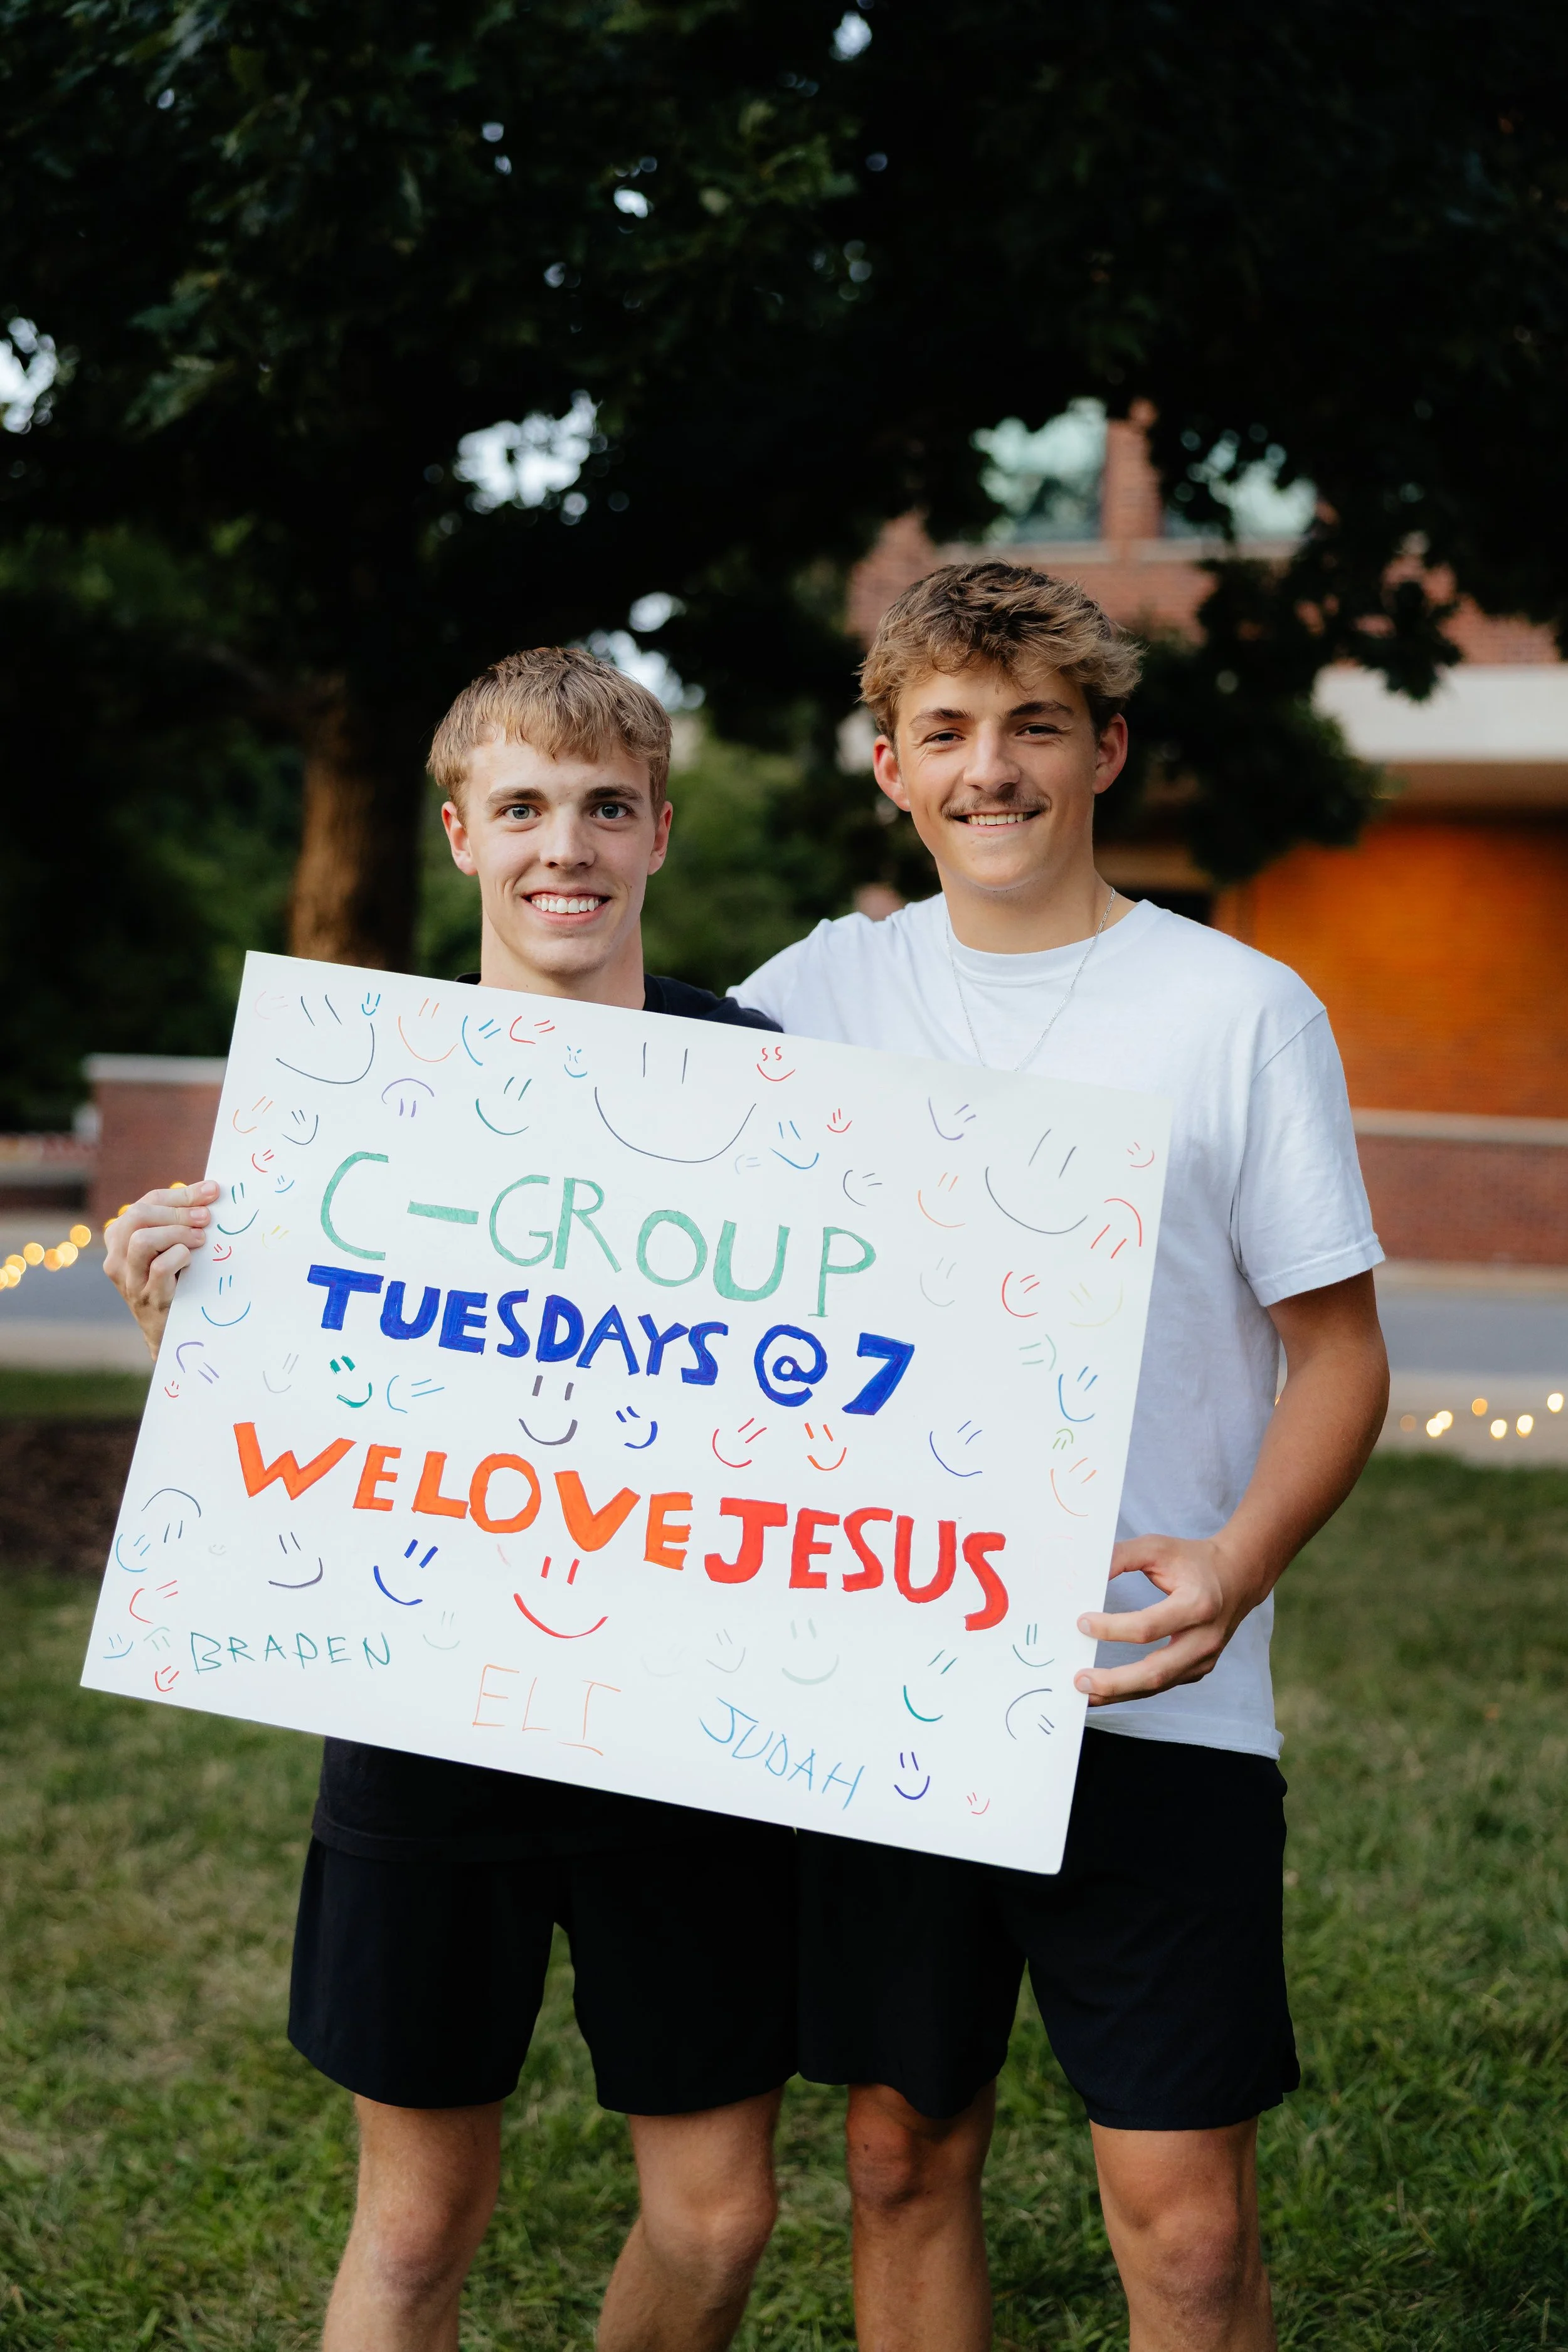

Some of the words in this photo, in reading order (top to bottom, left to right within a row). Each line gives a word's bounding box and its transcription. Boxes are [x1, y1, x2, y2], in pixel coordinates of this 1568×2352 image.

[320, 1152, 876, 1318] C-GROUP
[307, 1264, 729, 1385] TUESDAYS
[754, 1324, 828, 1407] @
[842, 1332, 915, 1416] 7
[704, 1497, 1009, 1631] JESUS
[472, 1664, 622, 1756] ELI
[699, 1697, 865, 1810] JUDAH
